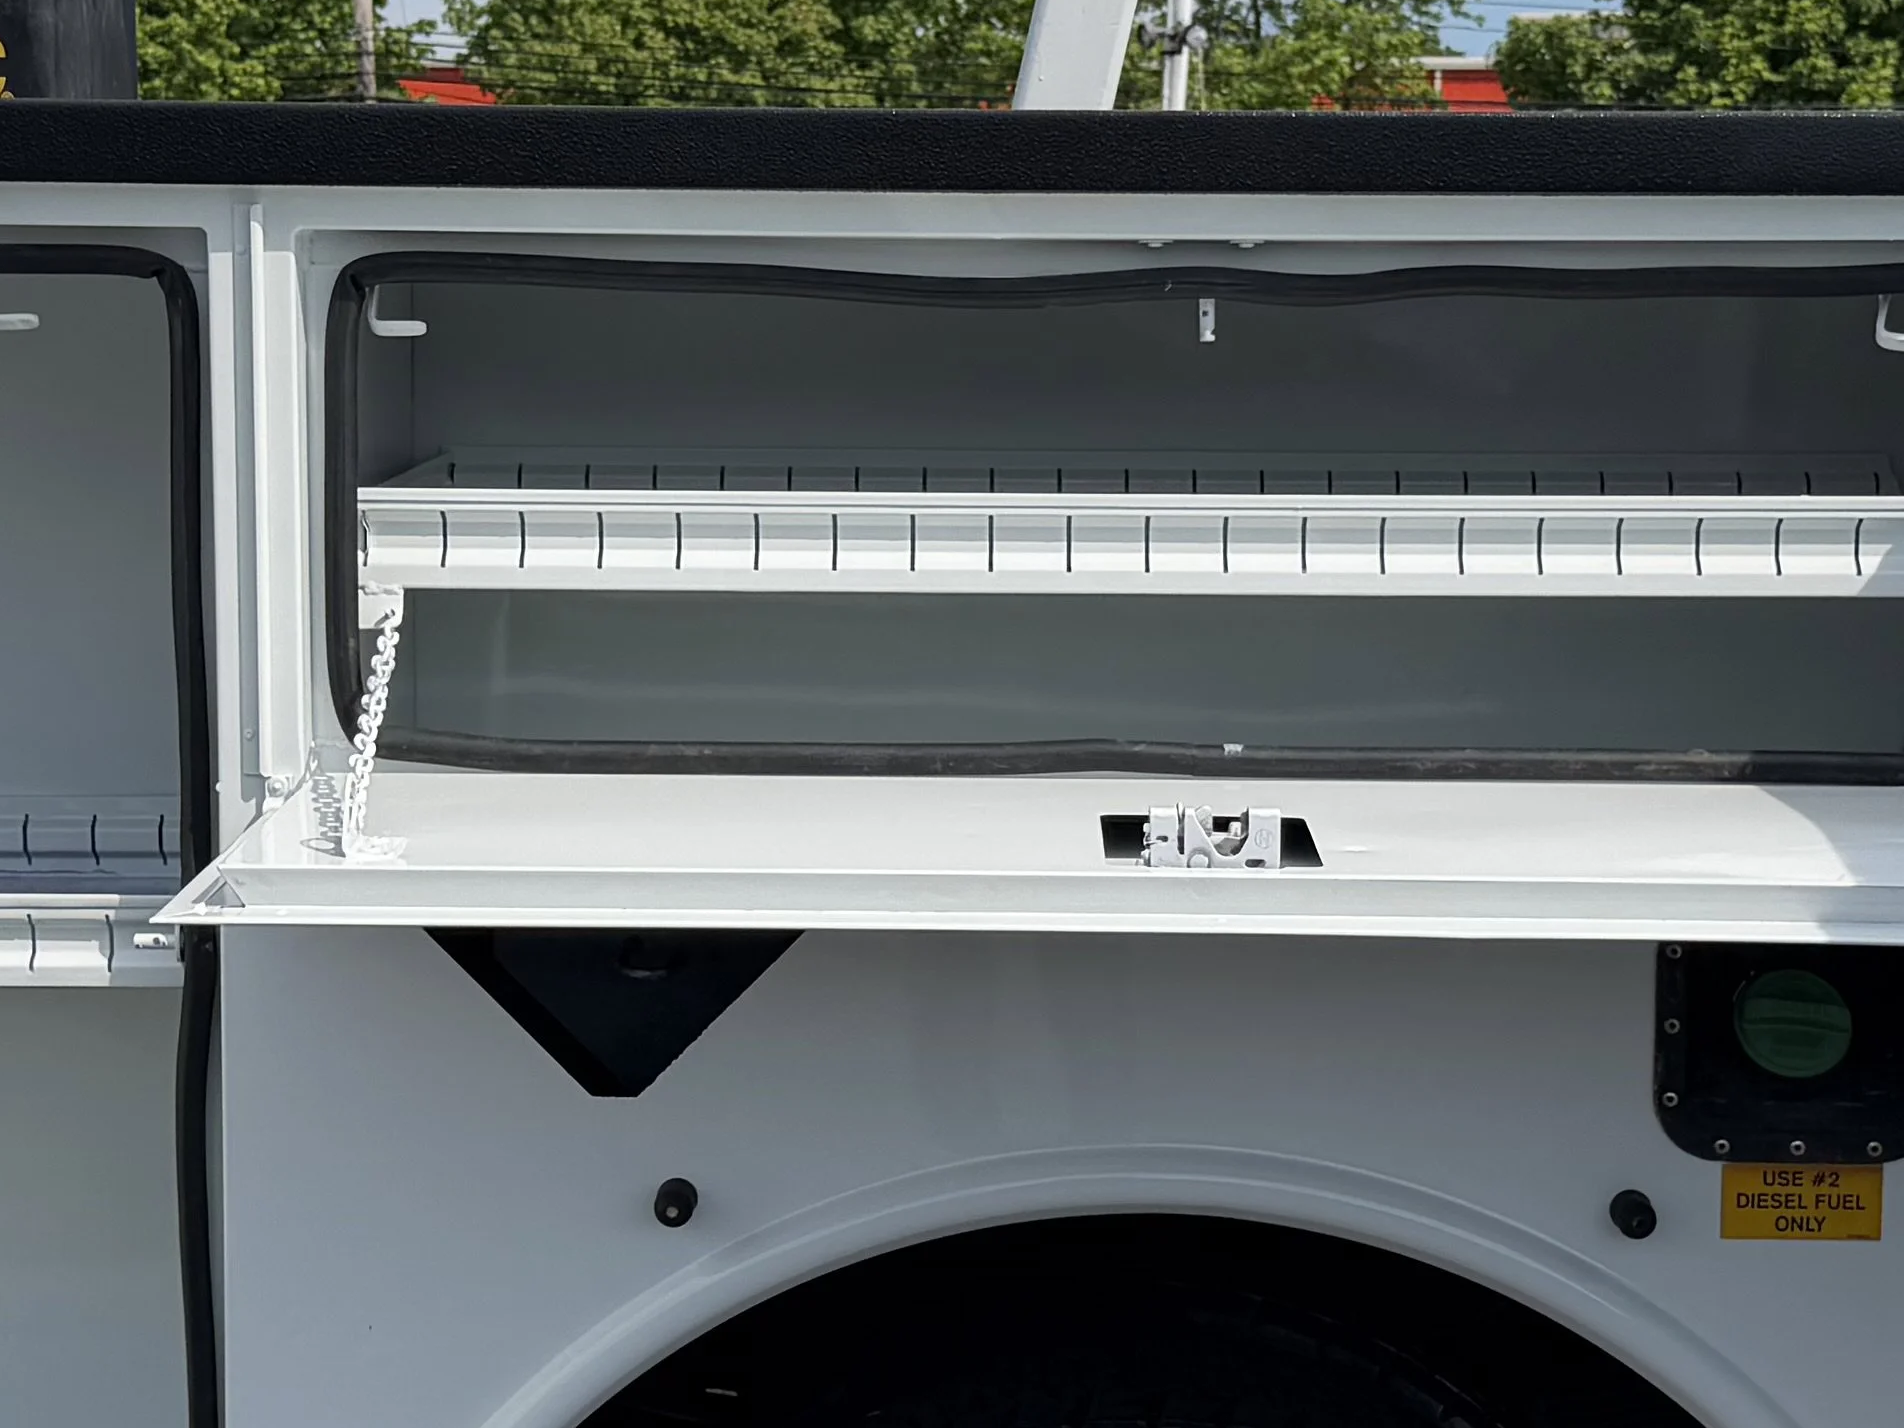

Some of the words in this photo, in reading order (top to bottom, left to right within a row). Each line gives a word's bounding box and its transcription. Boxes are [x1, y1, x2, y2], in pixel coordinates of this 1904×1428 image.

[1762, 1170, 1804, 1187] USE
[1812, 1172, 1840, 1188] #2
[1736, 1192, 1808, 1210] DIESEL
[1814, 1193, 1866, 1211] FUEL
[1775, 1215, 1827, 1233] ONLY
